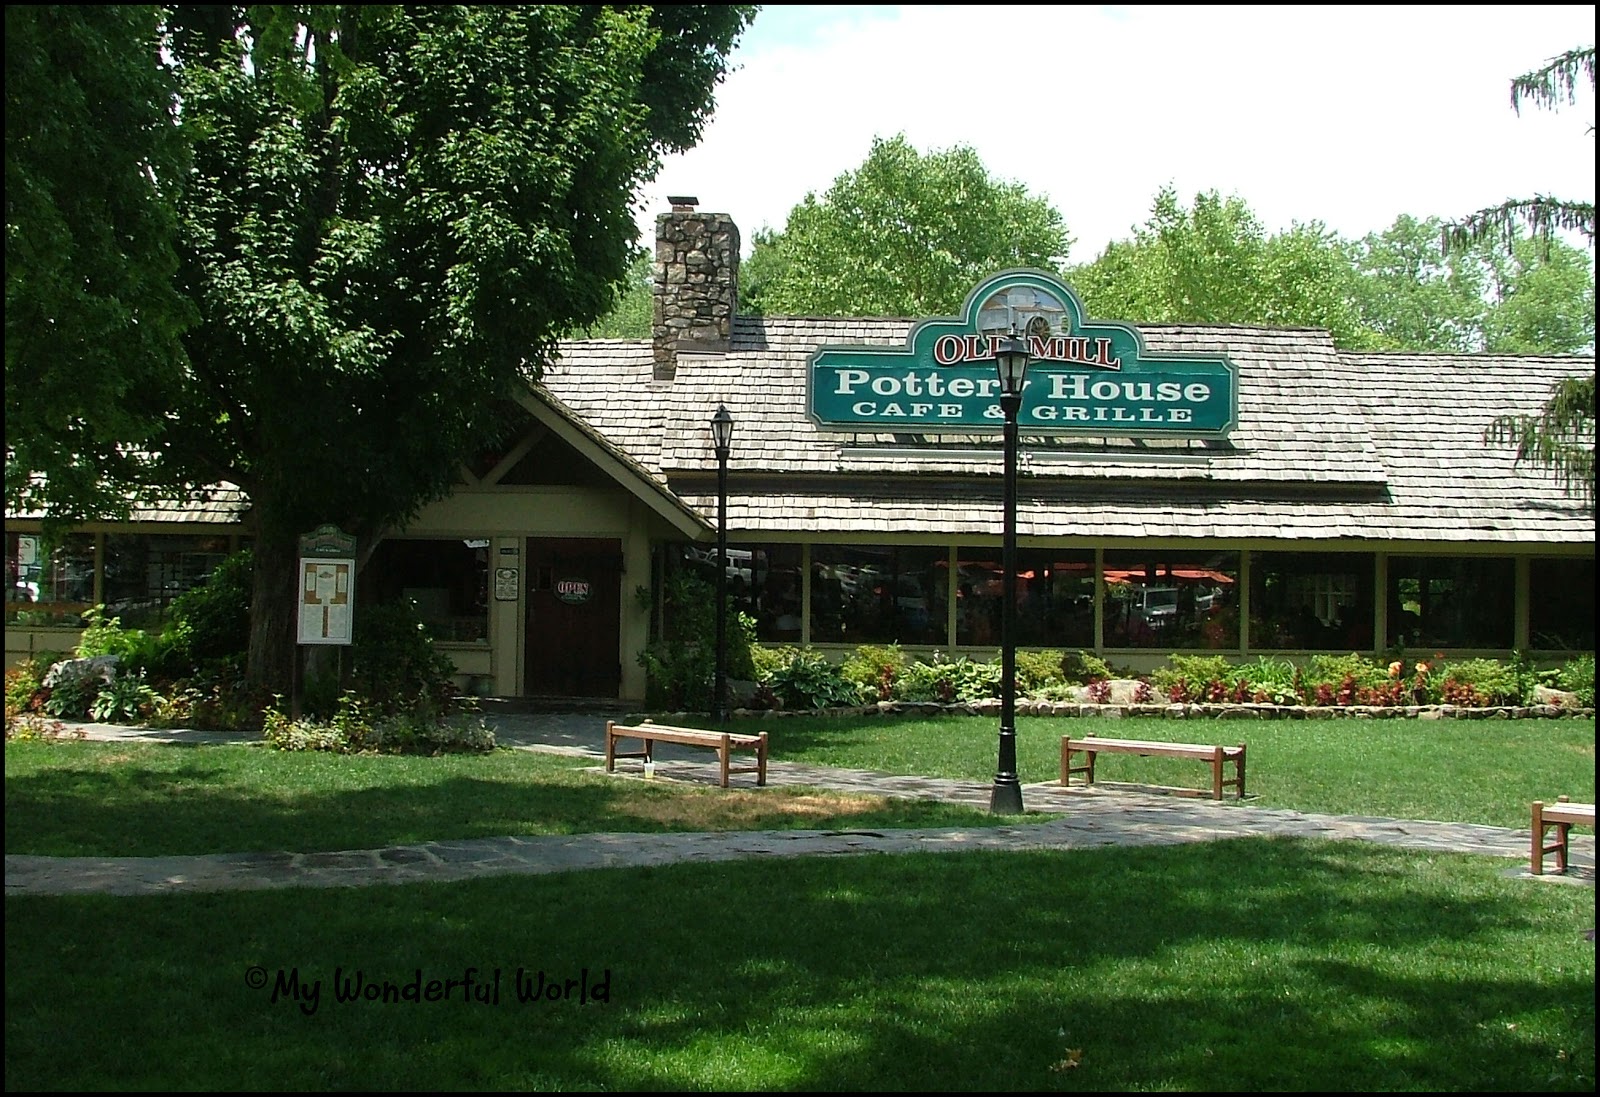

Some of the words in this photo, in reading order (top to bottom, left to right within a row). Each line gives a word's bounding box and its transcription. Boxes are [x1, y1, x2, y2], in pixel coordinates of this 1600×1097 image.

[1027, 334, 1121, 371] MILL
[833, 370, 1031, 397] Potter
[1048, 375, 1211, 402] House
[852, 402, 963, 418] CAFE
[983, 404, 1006, 419] &
[1032, 405, 1193, 422] GRILLE
